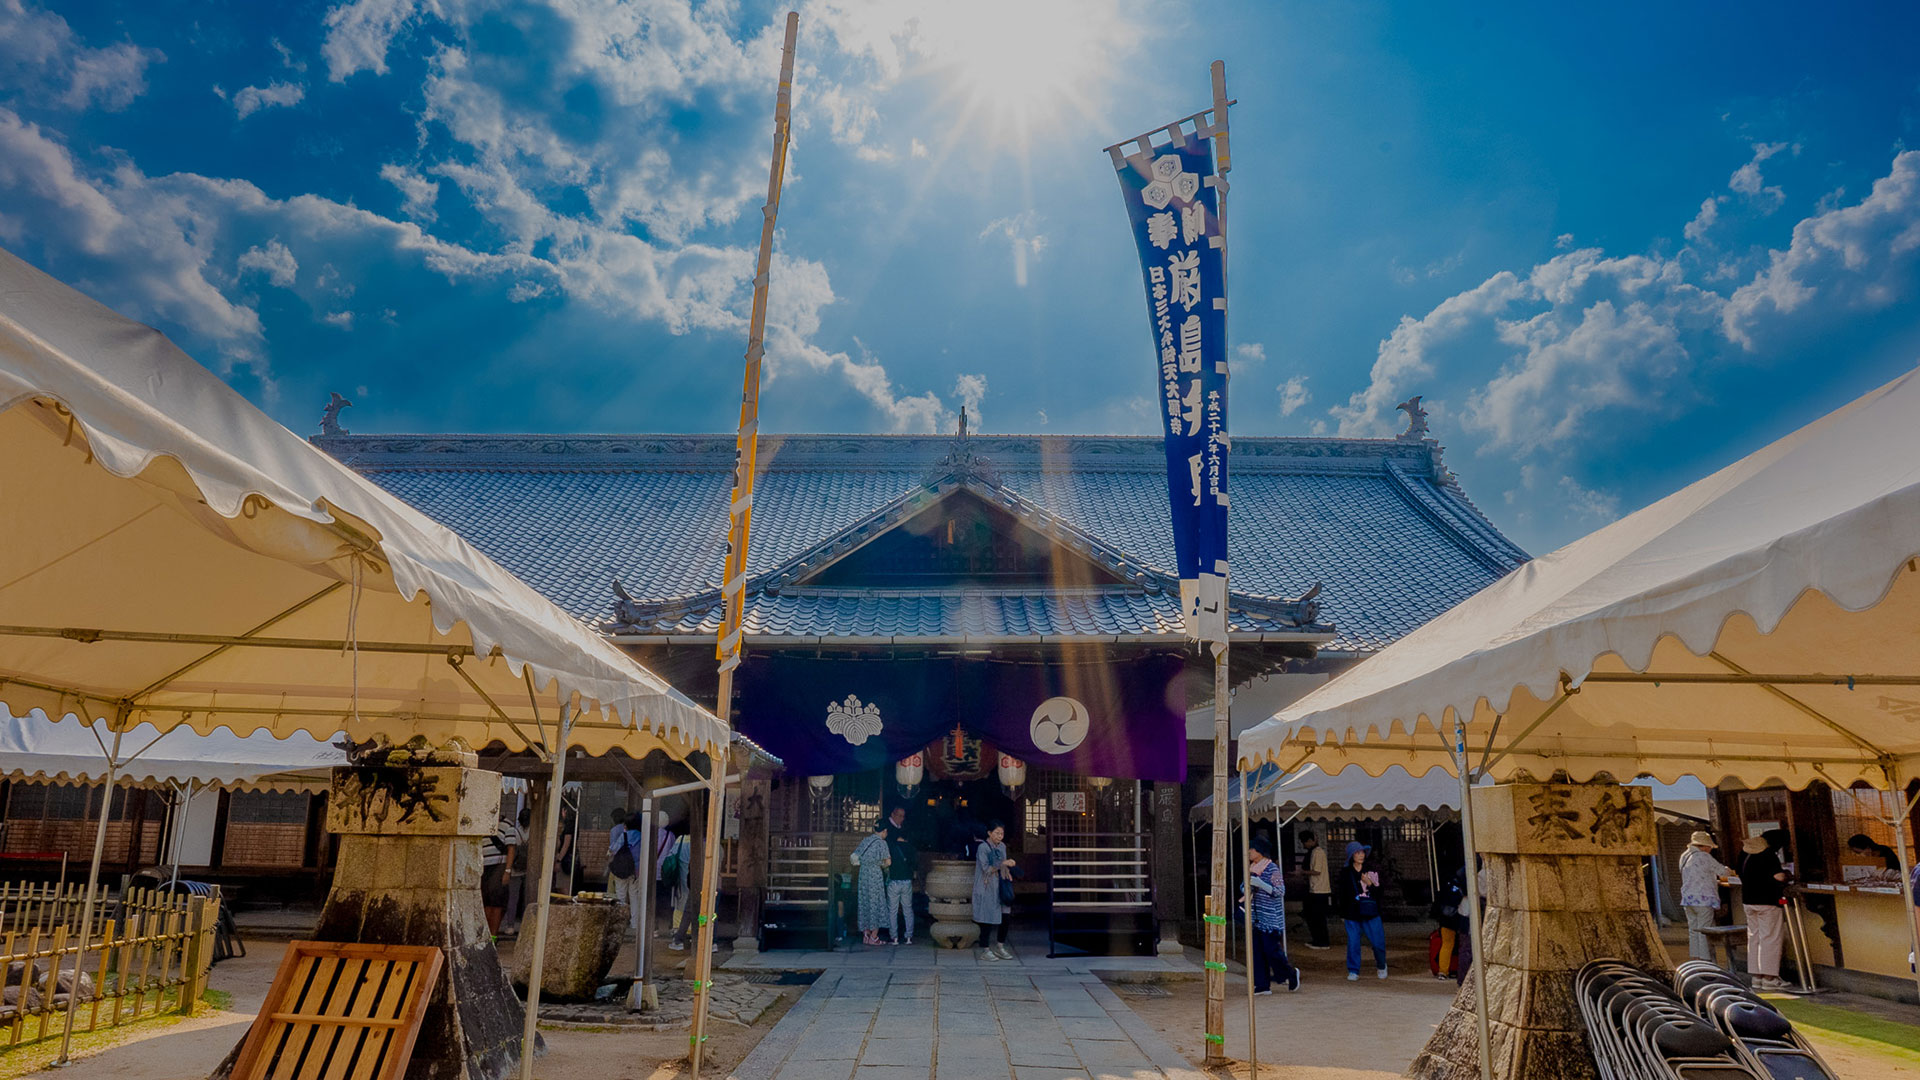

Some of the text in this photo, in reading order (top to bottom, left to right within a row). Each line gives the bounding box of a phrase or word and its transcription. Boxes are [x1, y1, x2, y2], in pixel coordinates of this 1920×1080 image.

[1149, 266, 1183, 436] 日本三大弁財天大願寺
[1207, 390, 1221, 496] 平成二十六年六月吉日
